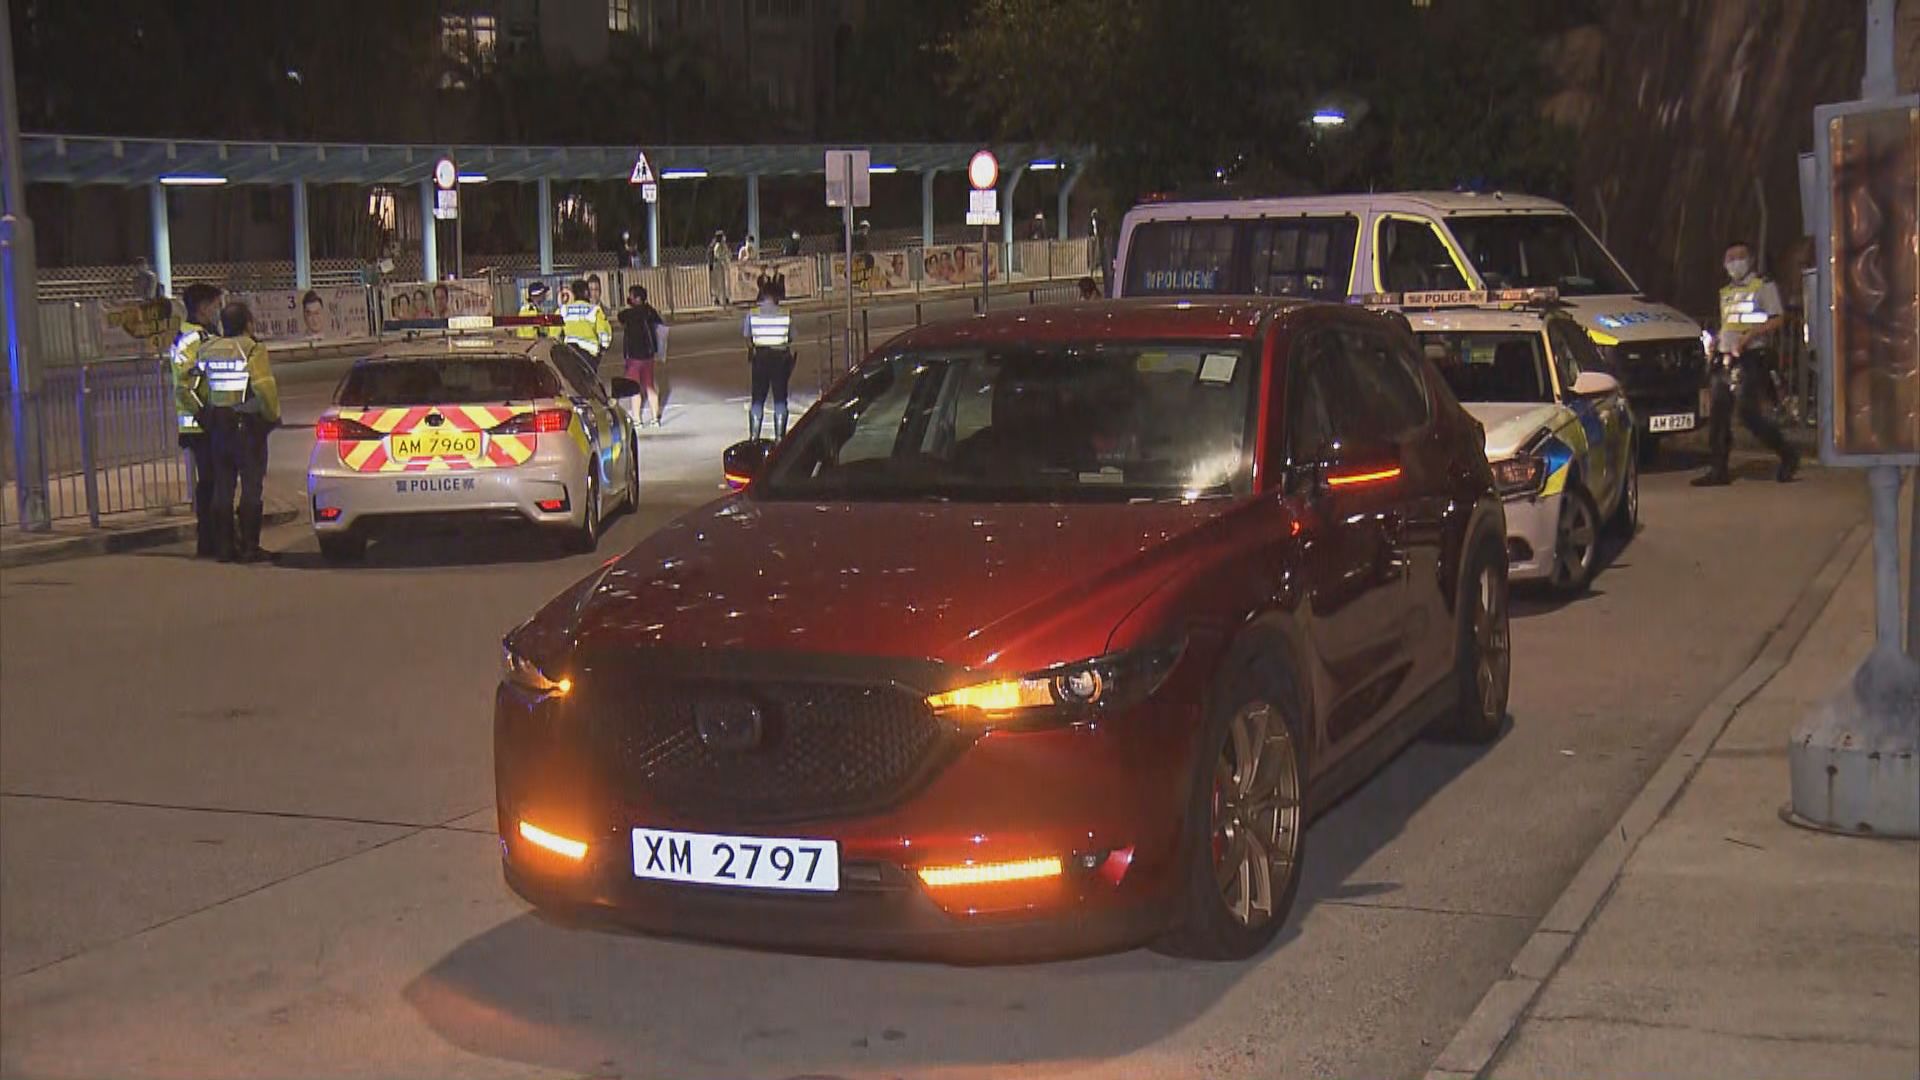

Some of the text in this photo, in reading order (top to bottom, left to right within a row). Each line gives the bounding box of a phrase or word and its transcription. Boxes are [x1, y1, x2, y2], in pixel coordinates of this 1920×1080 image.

[1156, 270, 1200, 289] POLICE
[287, 295, 297, 310] 3
[1424, 293, 1467, 304] POLICE
[1653, 416, 1667, 428] AM
[399, 438, 476, 454] AM 7960
[410, 478, 460, 492] POLICE
[644, 836, 823, 882] XM 2797
